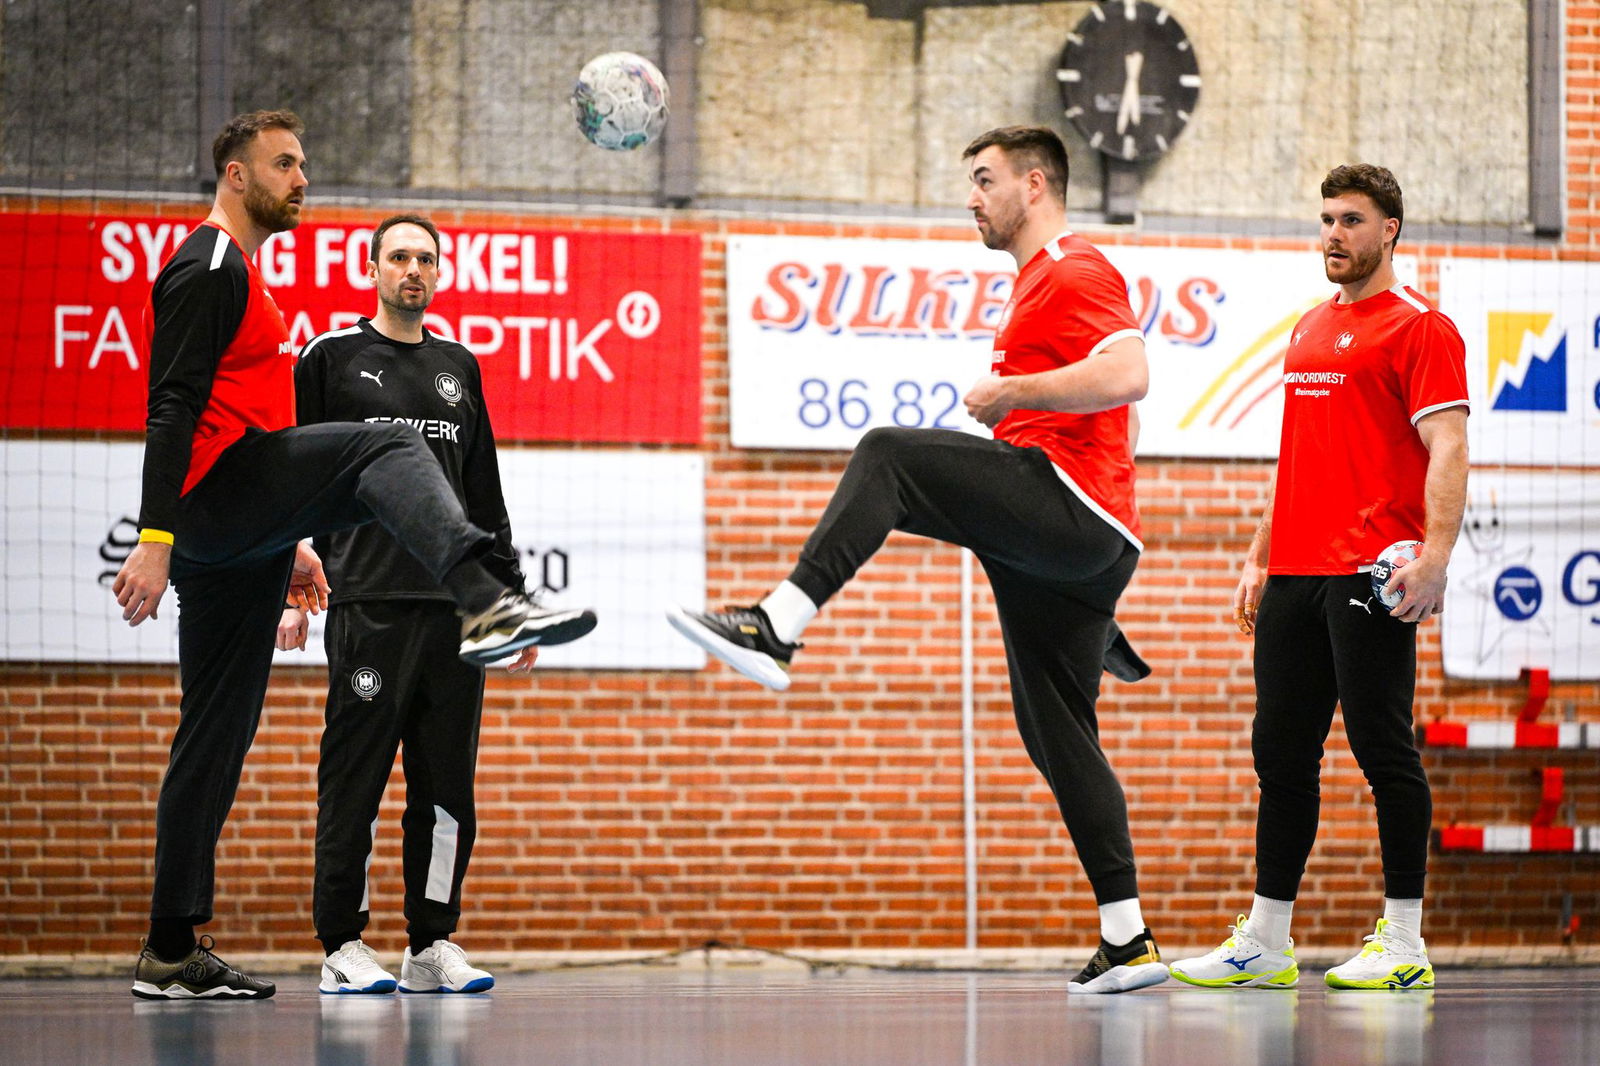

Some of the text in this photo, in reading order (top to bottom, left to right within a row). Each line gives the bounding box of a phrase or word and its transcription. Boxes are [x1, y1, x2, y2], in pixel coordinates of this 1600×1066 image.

[315, 228, 568, 295] FOSKEL!
[798, 378, 961, 430] 86 82
[1295, 372, 1346, 384] NORDWEST
